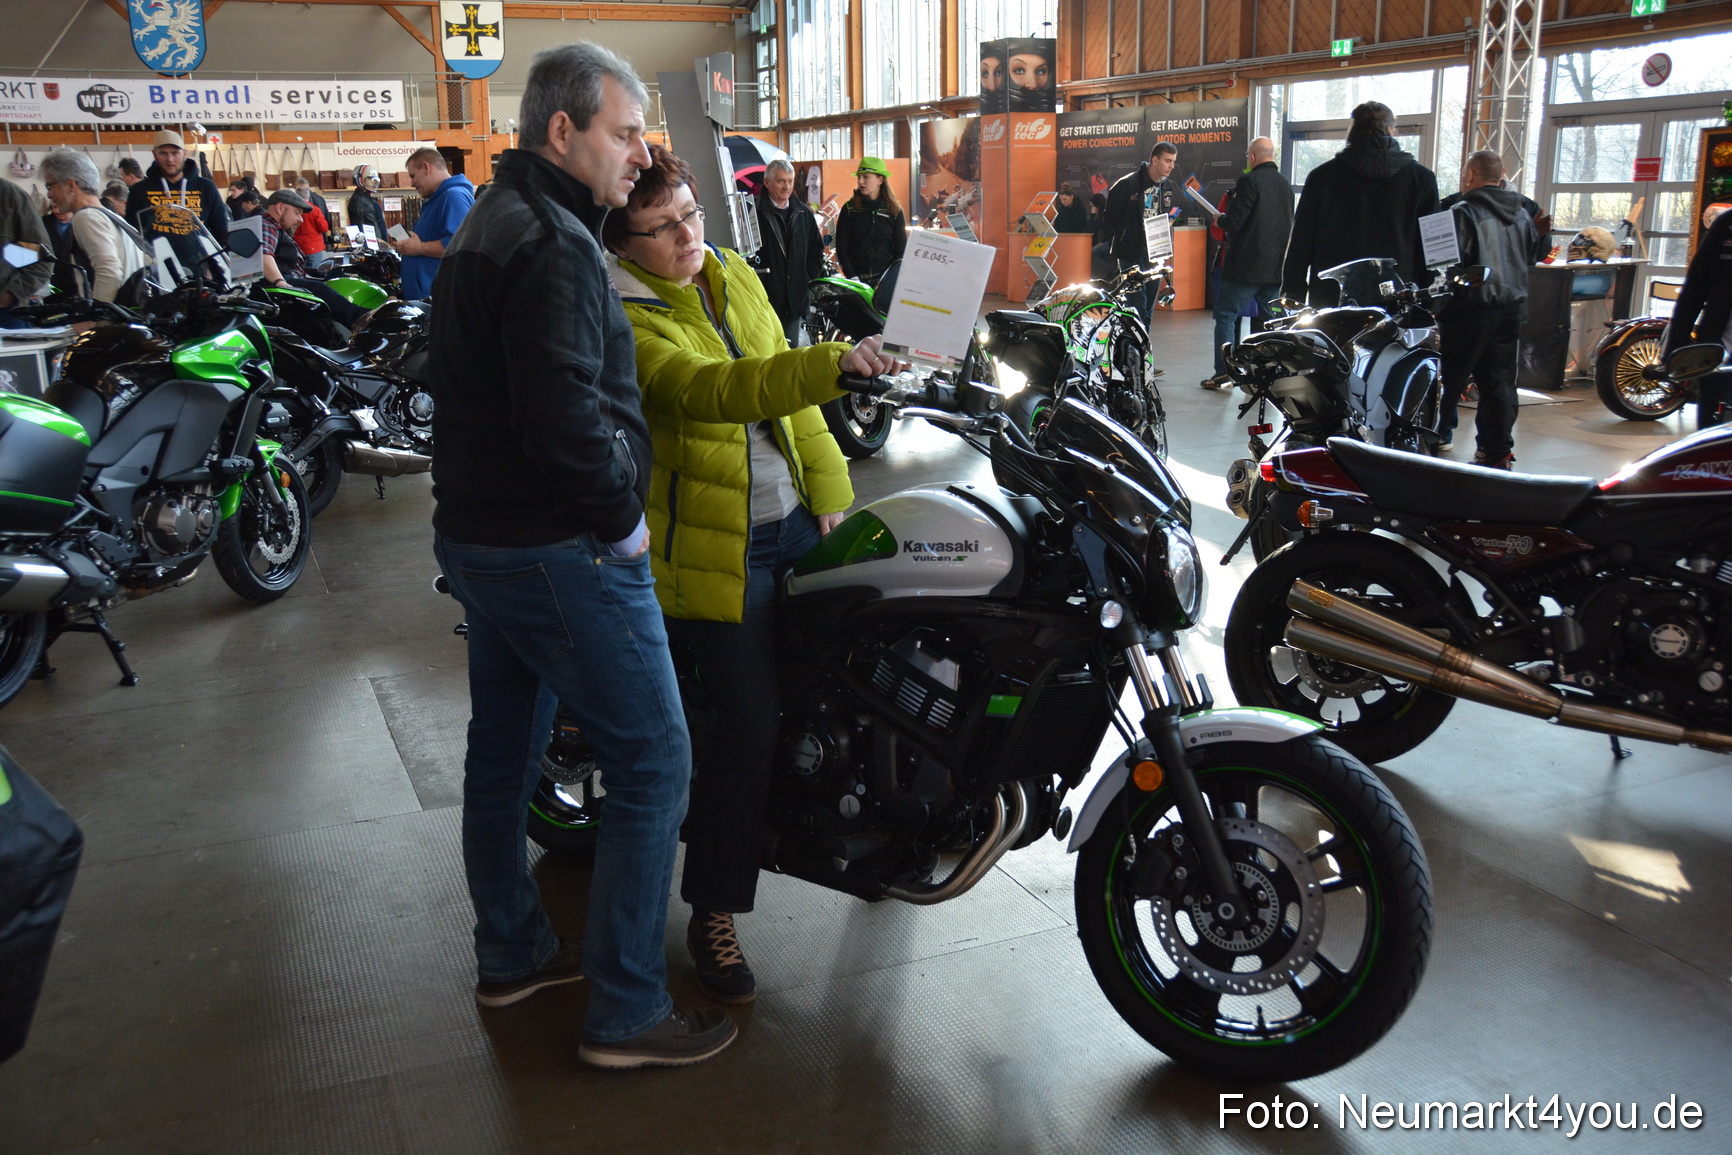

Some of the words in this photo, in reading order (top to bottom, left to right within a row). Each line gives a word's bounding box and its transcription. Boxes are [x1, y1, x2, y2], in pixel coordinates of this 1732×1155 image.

[148, 85, 251, 104] Brandl
[270, 86, 393, 104] services
[152, 109, 212, 119] einfach
[218, 109, 274, 119] schnell
[294, 109, 364, 119] Glasfaser
[369, 109, 394, 119] DSL
[1060, 127, 1073, 137] GET
[1073, 124, 1105, 136] STARTET
[1106, 122, 1139, 135] WITHOUT
[1151, 121, 1166, 132] GET
[1167, 119, 1194, 131] READY
[1196, 118, 1212, 129] FOR
[1214, 116, 1239, 127] YOUR
[1014, 132, 1035, 140] tec
[1063, 138, 1088, 149] POWER
[1088, 136, 1135, 148] CONNECTION
[1156, 133, 1186, 144] MOTOR
[1188, 131, 1232, 144] MOMENTS
[914, 248, 922, 258] €
[903, 540, 979, 553] Kawasaki
[1200, 730, 1232, 739] ABS
